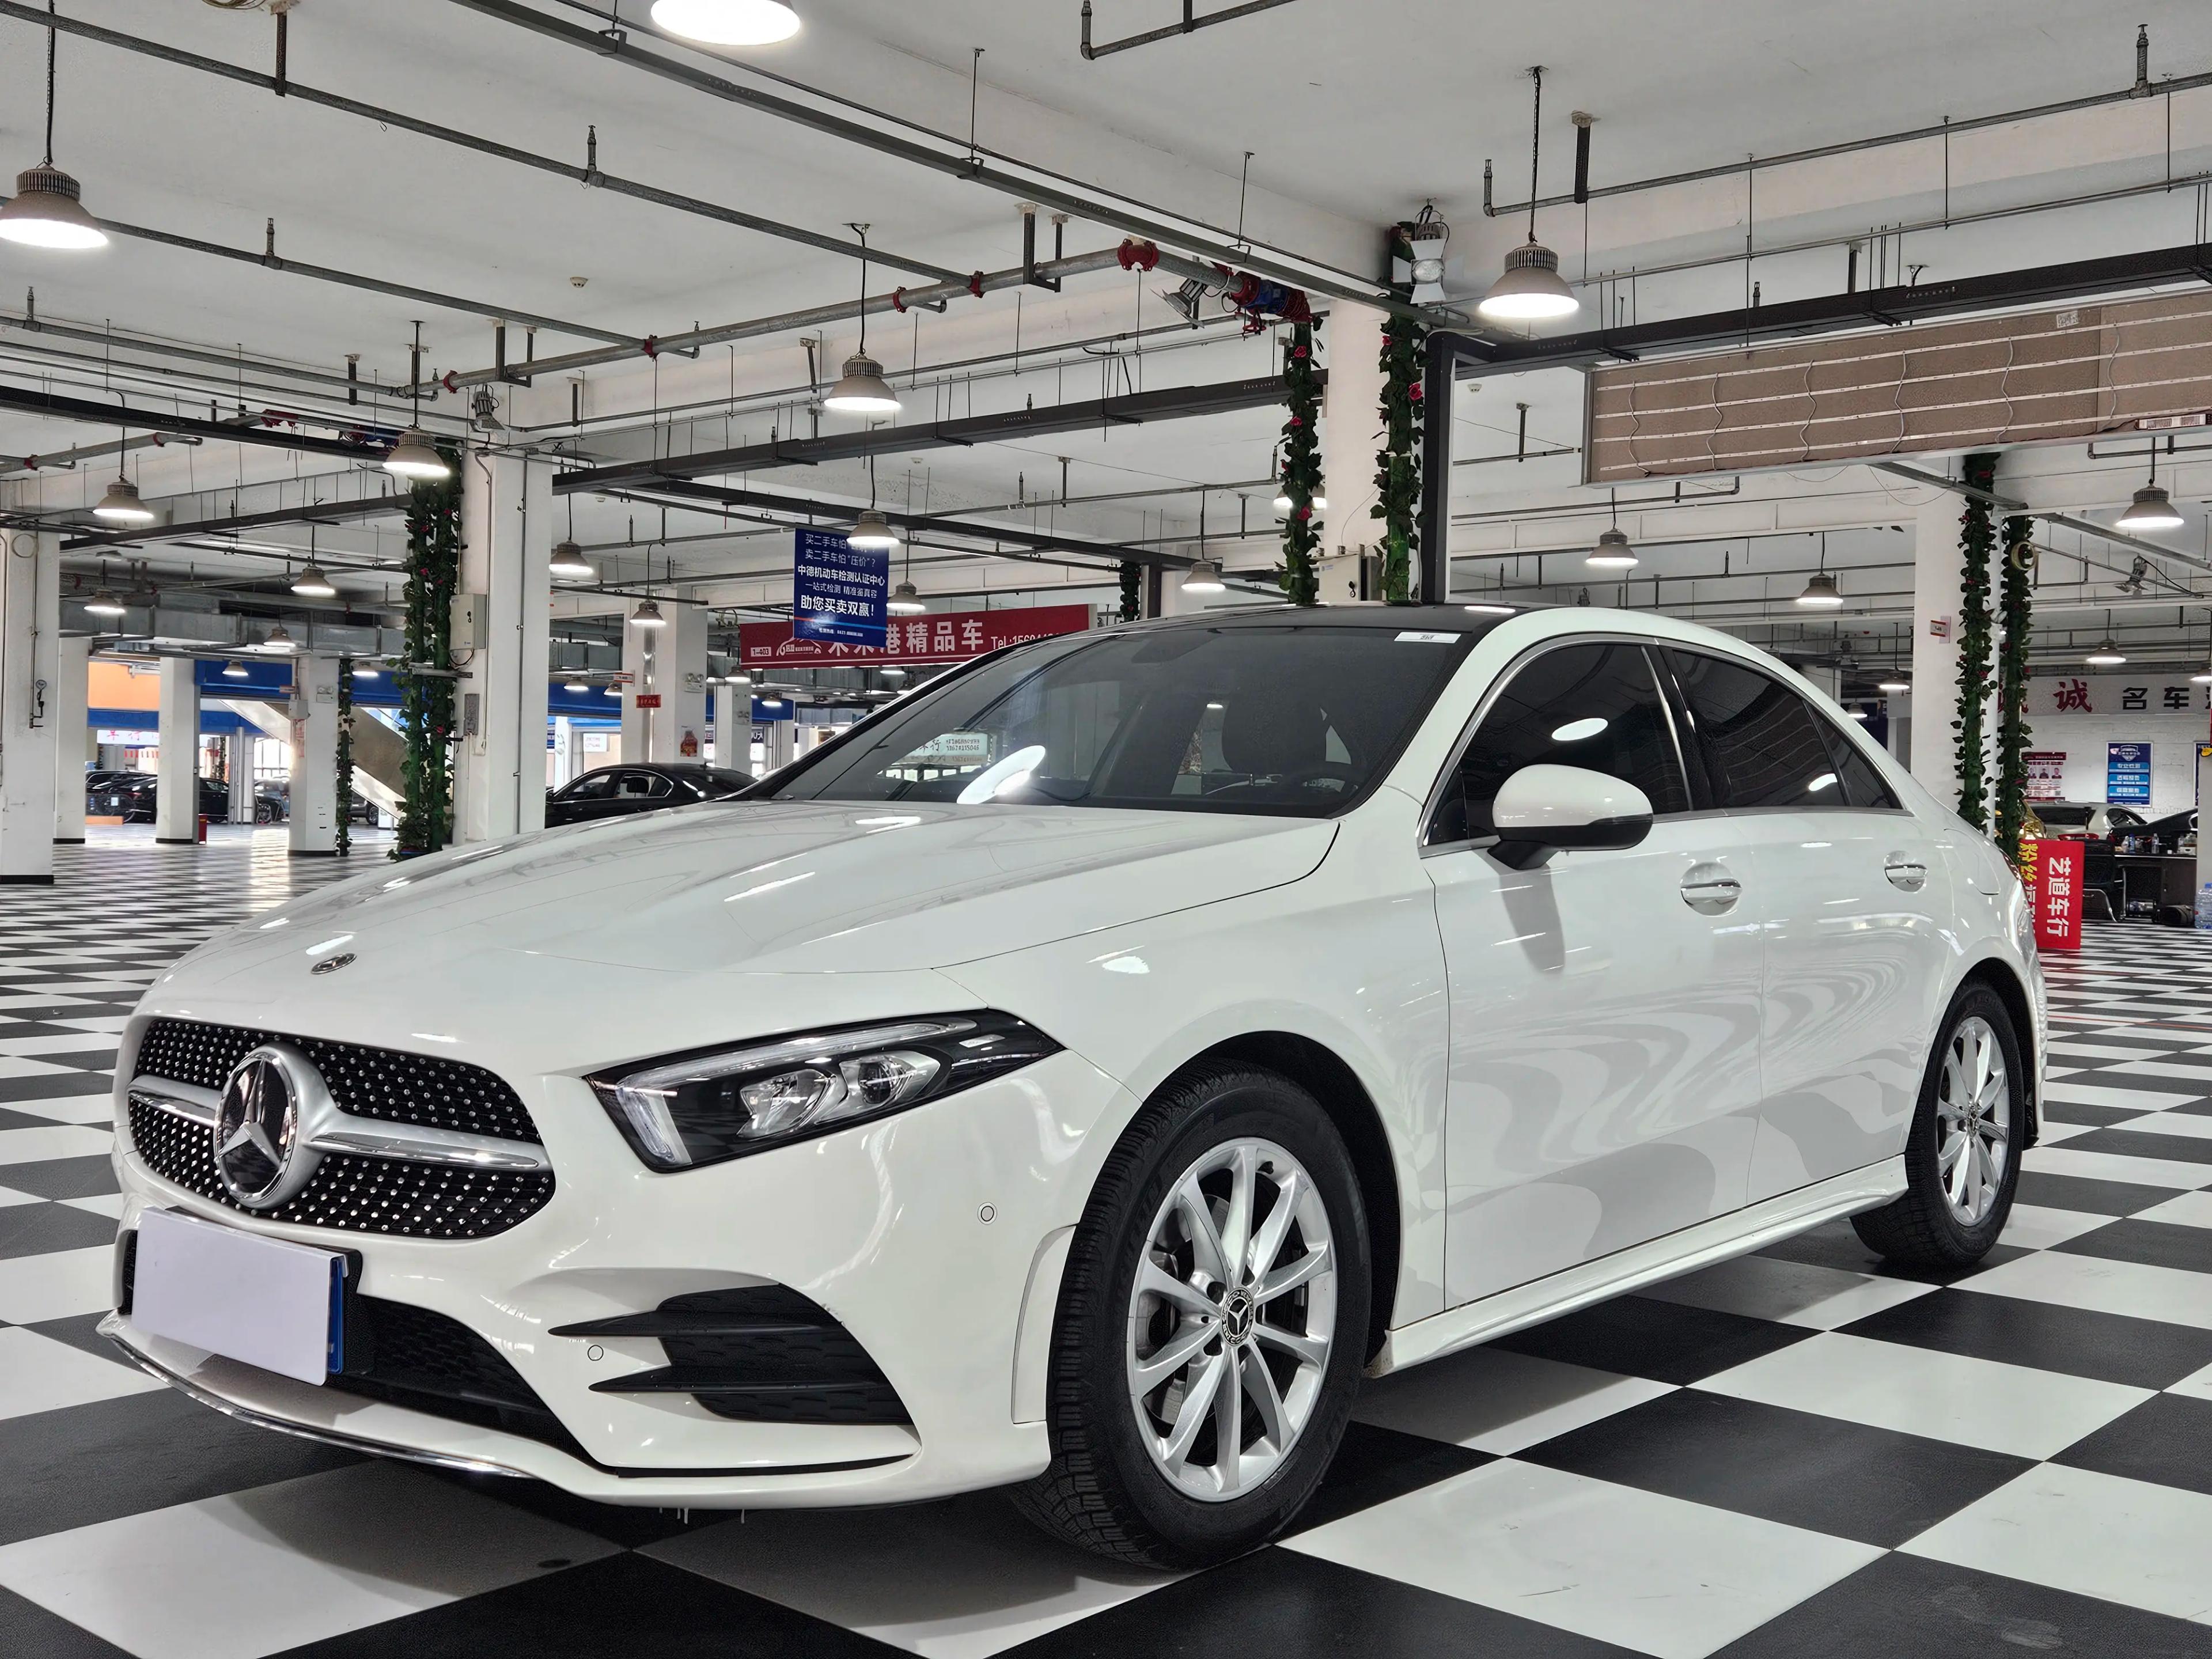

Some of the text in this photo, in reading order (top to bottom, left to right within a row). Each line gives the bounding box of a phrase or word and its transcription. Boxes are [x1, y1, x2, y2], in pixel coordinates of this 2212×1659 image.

[798, 565, 885, 586] 中德机动车检测认证中心
[2047, 857, 2071, 937] 艺道车行
